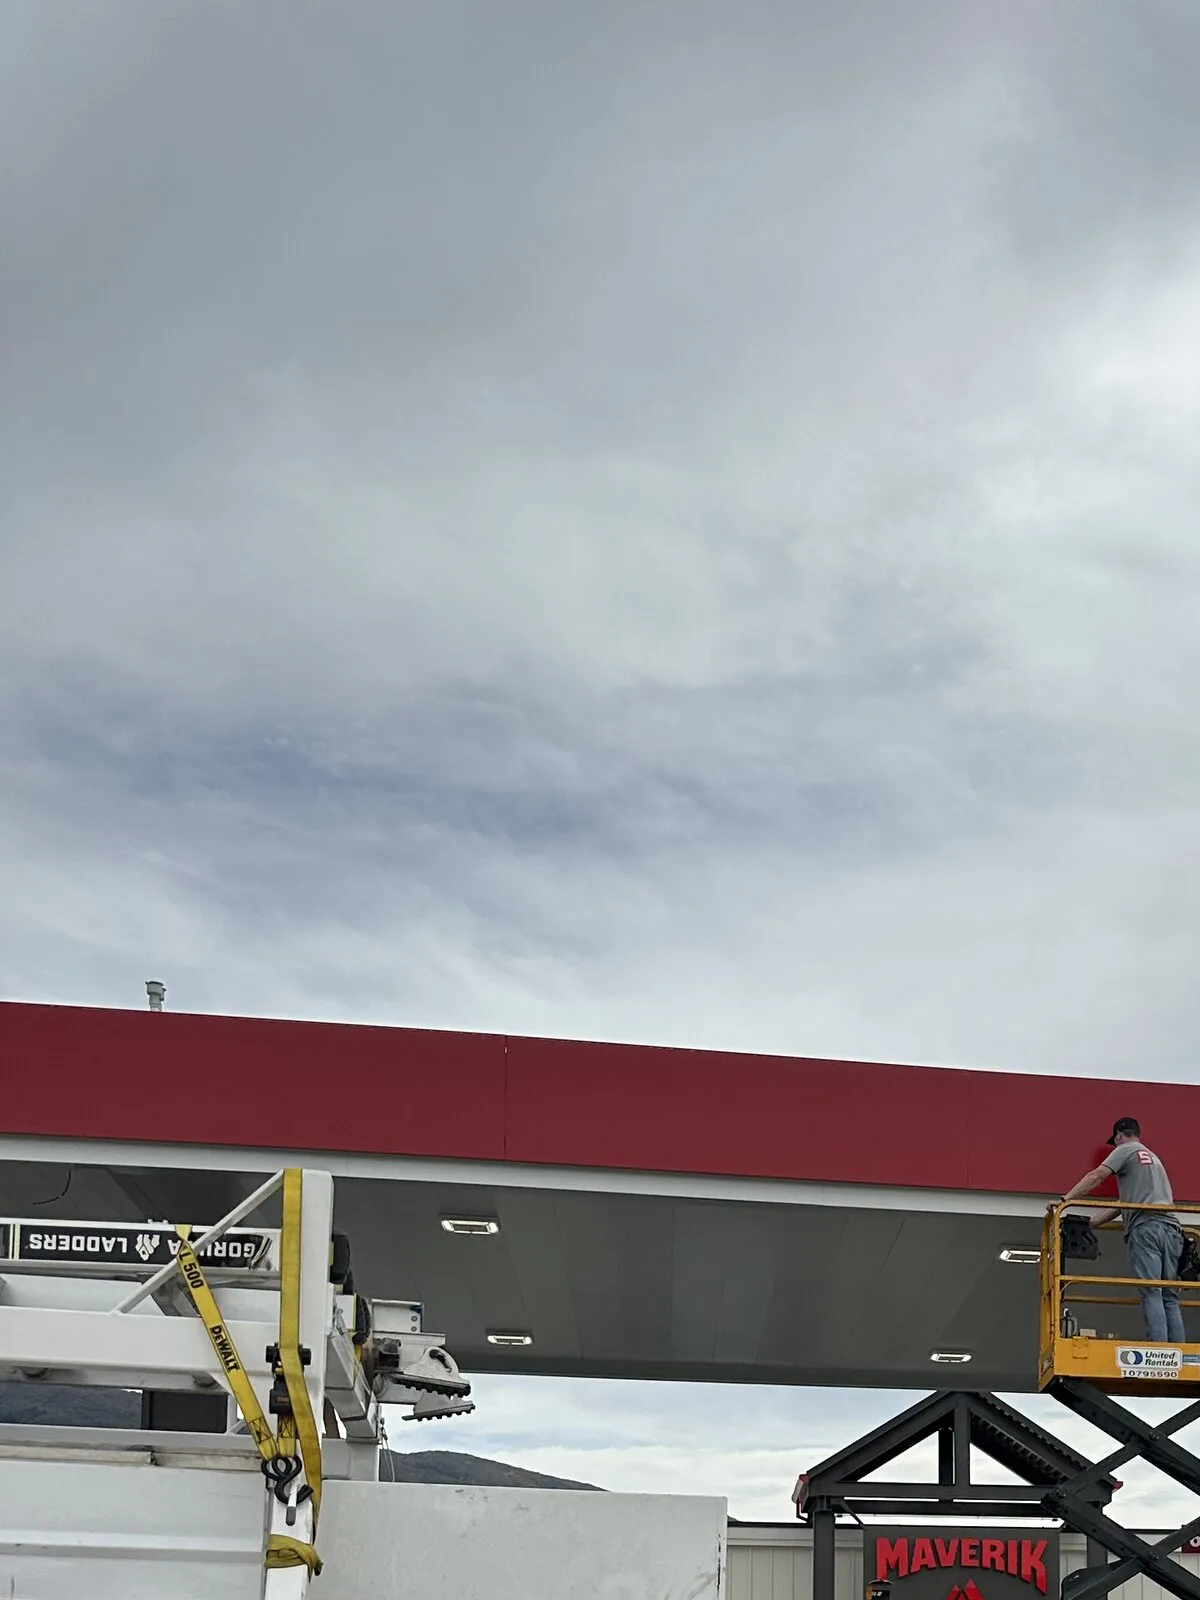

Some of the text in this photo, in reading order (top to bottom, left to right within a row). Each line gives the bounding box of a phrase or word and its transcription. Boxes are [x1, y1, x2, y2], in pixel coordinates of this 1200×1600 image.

[29, 1232, 256, 1258] GORIA LADDERS
[183, 1261, 204, 1289] 500
[1144, 1359, 1179, 1368] Rentals
[1145, 1351, 1176, 1360] United
[875, 1537, 1048, 1596] MAVERIK
